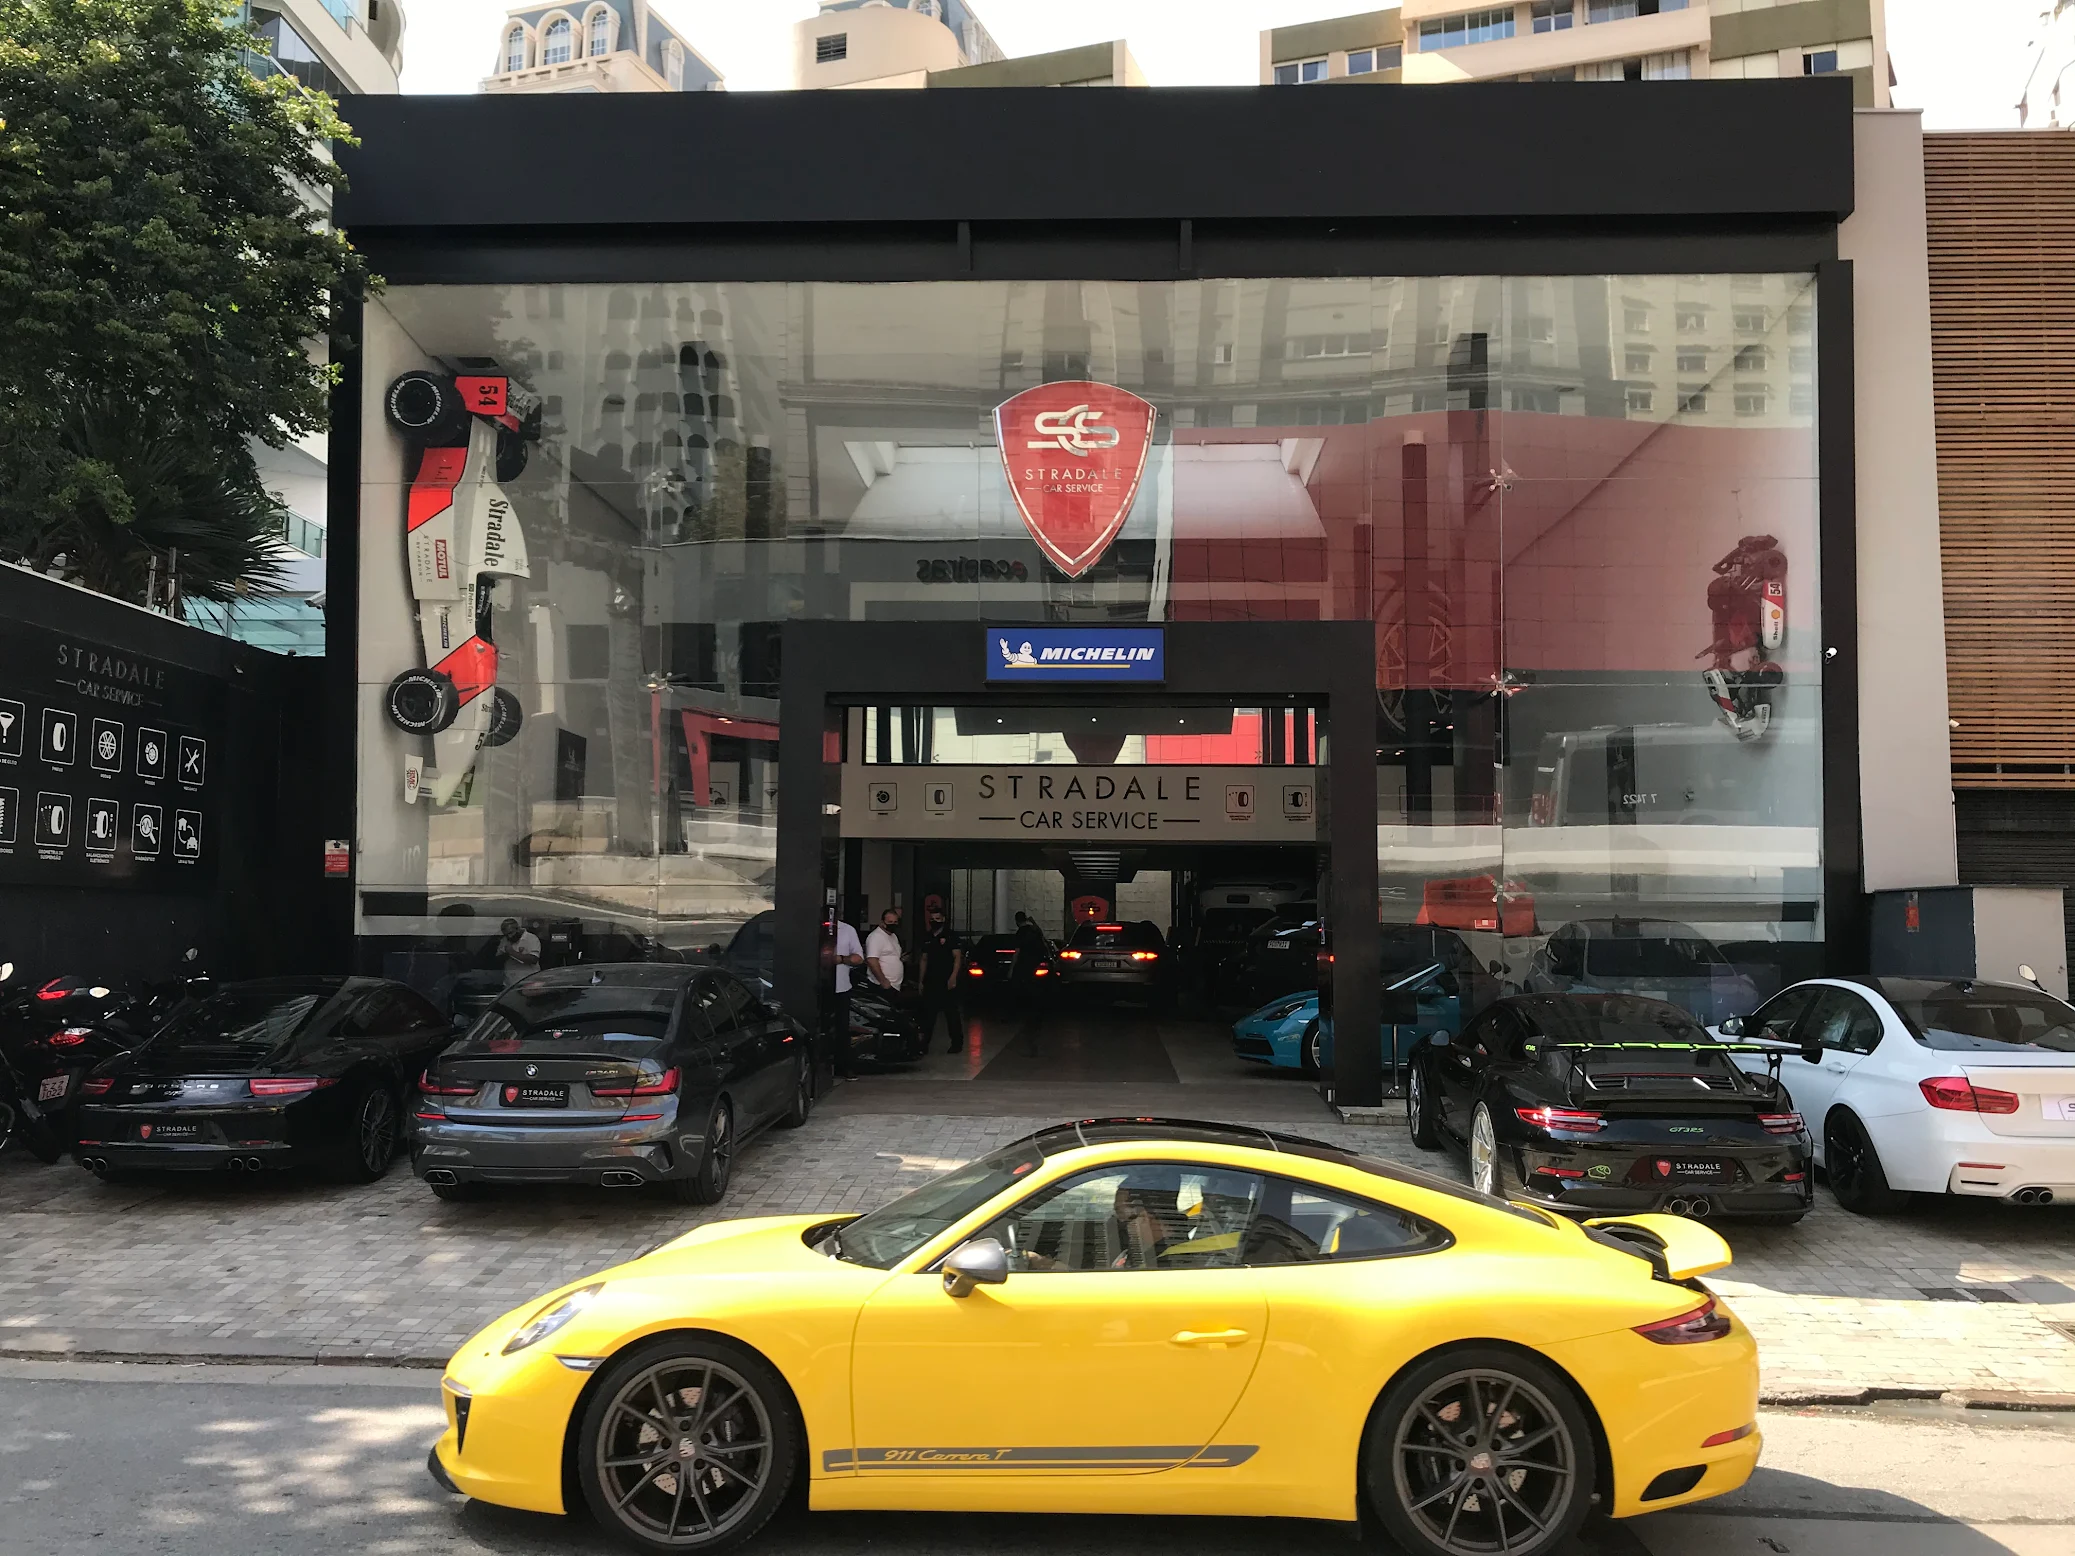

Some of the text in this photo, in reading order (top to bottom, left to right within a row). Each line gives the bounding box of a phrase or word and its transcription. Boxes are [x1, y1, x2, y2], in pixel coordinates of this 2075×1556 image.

[390, 380, 406, 420] MICHELIN
[427, 385, 443, 425] MICHELIN
[478, 385, 499, 407] 54
[1025, 467, 1123, 481] STRADALE
[1043, 483, 1104, 494] CAR SERVICE
[483, 498, 509, 567] Stradale
[423, 534, 433, 583] STRADALE
[436, 541, 449, 578] MOTUL
[1772, 621, 1780, 642] Shell
[1040, 647, 1155, 661] MICHELIN
[58, 644, 164, 690] STRADALE
[77, 679, 144, 708] CAR SERVICE
[408, 675, 443, 699] MICHELIN
[391, 704, 426, 728] MICHELIN
[474, 732, 485, 751] 5
[978, 774, 1201, 800] STRADALE
[1020, 810, 1159, 831] CAR SERVICE
[522, 1089, 565, 1097] STRADALE
[884, 1449, 1012, 1461] 911 Carrera T
